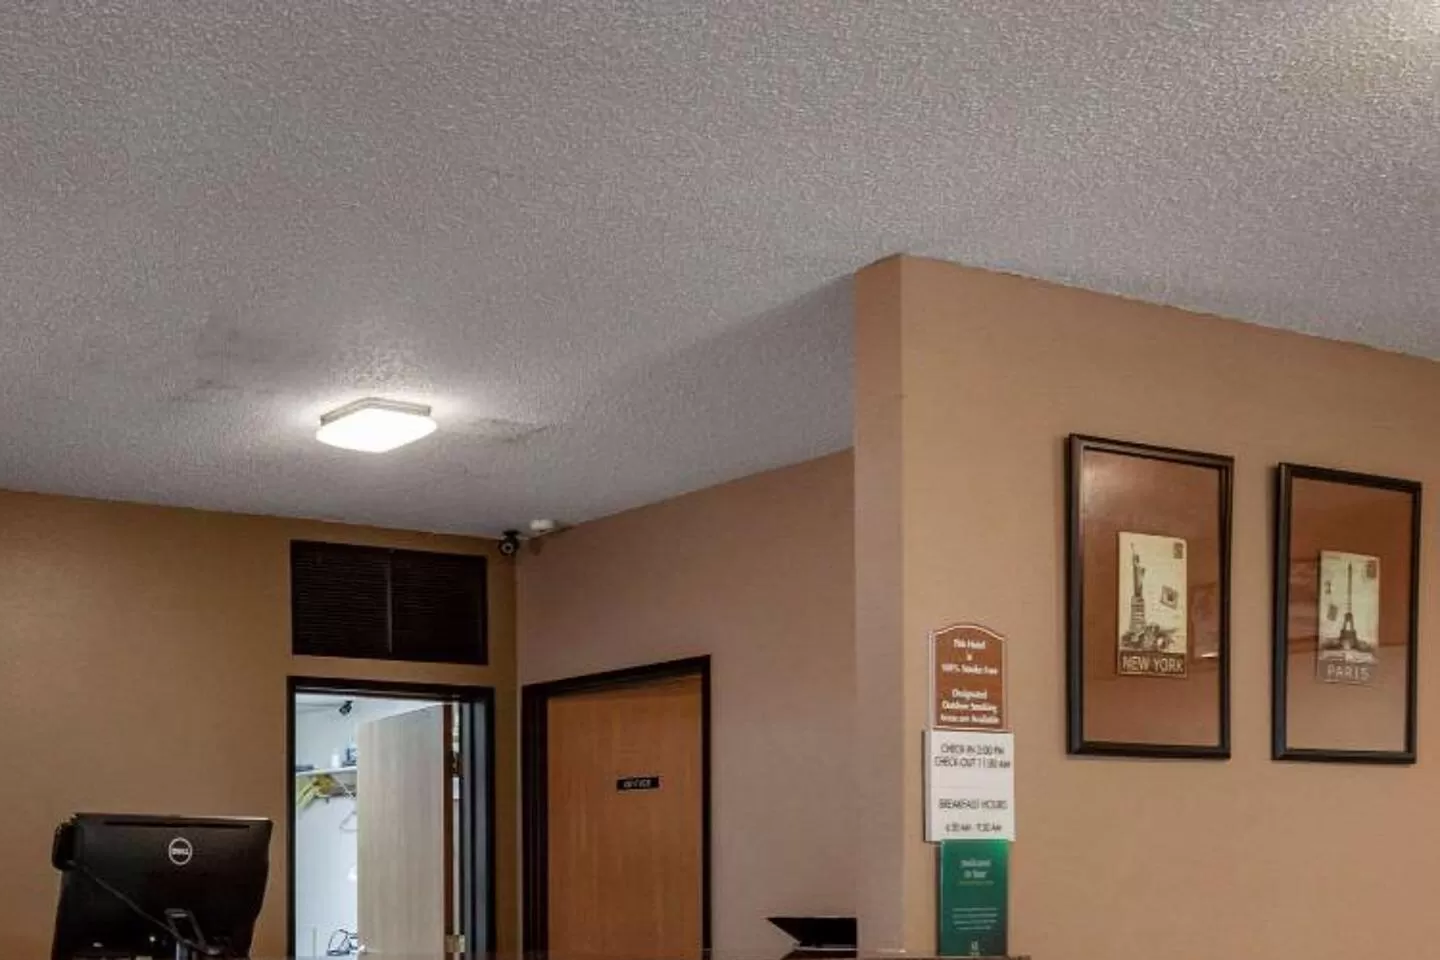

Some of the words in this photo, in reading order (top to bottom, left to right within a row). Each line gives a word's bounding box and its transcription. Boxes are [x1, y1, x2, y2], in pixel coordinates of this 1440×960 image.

[1122, 655, 1150, 670] NEW
[1153, 657, 1184, 672] YORK
[1327, 663, 1370, 681] PARIS
[940, 743, 965, 754] CHECK
[966, 744, 976, 754] IN
[992, 745, 1005, 755] PM
[934, 756, 958, 767] CHECK
[959, 757, 976, 768] OUT
[997, 759, 1011, 769] AM
[939, 798, 979, 809] BREAKFAST
[981, 800, 1008, 809] HOURS
